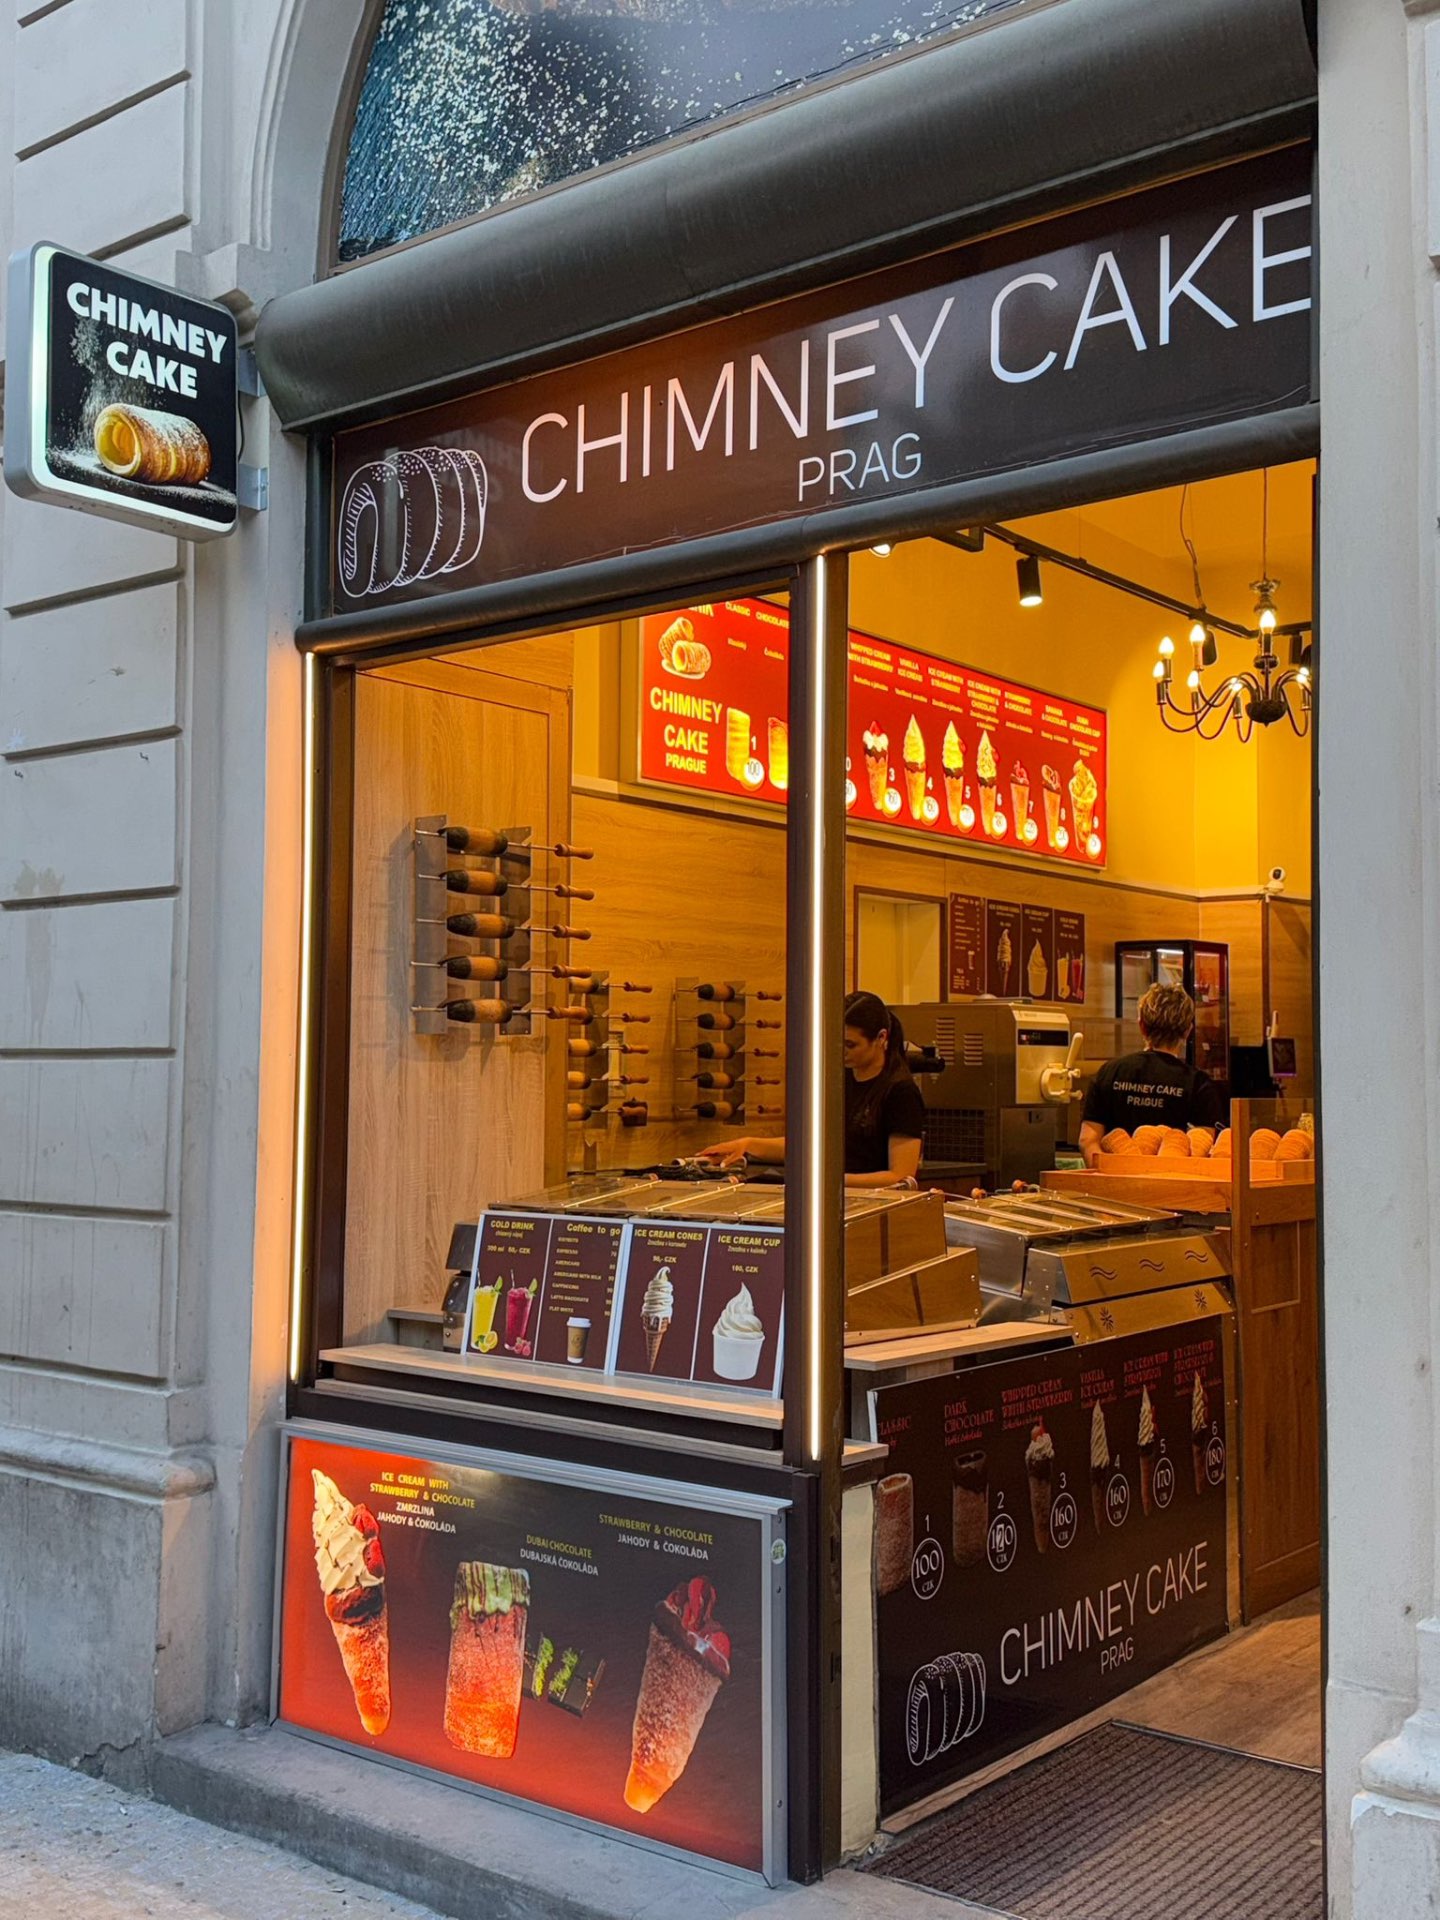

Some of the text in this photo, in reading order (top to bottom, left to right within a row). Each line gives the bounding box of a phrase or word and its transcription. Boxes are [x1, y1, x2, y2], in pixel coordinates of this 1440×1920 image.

[66, 282, 227, 364] CHIMNEY
[522, 193, 1311, 503] CHIMNEY CAKE
[106, 341, 198, 399] CAKE
[799, 432, 922, 502] PRAG
[650, 687, 722, 724] CHIMNEY
[664, 724, 708, 754] CAKE
[751, 735, 757, 750] 1
[665, 753, 707, 774] PRAGUE
[889, 767, 896, 782] 3
[927, 776, 933, 790] 4
[965, 785, 971, 799] 5
[1029, 800, 1034, 813] 7
[1113, 1081, 1184, 1097] CHIMNEY CAKE
[1127, 1095, 1164, 1108] PRAGUE
[490, 1220, 535, 1231] COLD DRINK
[567, 1223, 620, 1237] Coffee to go
[634, 1229, 703, 1241] ICE CREAM CONES
[718, 1235, 781, 1247] ICE CREAM CUP
[664, 1255, 677, 1263] CZK
[745, 1265, 759, 1273] CZK
[944, 1400, 967, 1419] DARK
[944, 1409, 995, 1434] CHOCOLATE
[1212, 1420, 1217, 1436] 6
[1160, 1438, 1166, 1454] 5
[1114, 1454, 1120, 1469] 4
[1208, 1446, 1222, 1466] 180
[381, 1472, 449, 1490] ICE CREAM WITH
[1059, 1473, 1067, 1489] 3
[1157, 1468, 1171, 1489] 170
[370, 1482, 476, 1509] STRAWBERRY & CHOCOLATE
[997, 1491, 1005, 1509] 2
[1110, 1485, 1127, 1506] 160
[396, 1501, 435, 1517] ZMRZLINA
[1055, 1504, 1073, 1528] 160
[376, 1511, 456, 1534] JAHODY & ČOKOLÁDA
[599, 1513, 714, 1545] STRAWBERRY & CHOCOLATE
[925, 1514, 930, 1533] 1
[526, 1534, 593, 1559] DUBAI CHOCOLATE
[617, 1533, 709, 1561] JAHODY & ČOKOLÁDA
[520, 1548, 599, 1577] DUBAJSKÁ ČOKOLÁDA
[915, 1549, 940, 1580] 100
[996, 1553, 1009, 1565] CZK
[921, 1580, 934, 1593] CZK
[1001, 1541, 1208, 1685] CHIMNEY CAKE
[1101, 1636, 1135, 1675] PRAG
